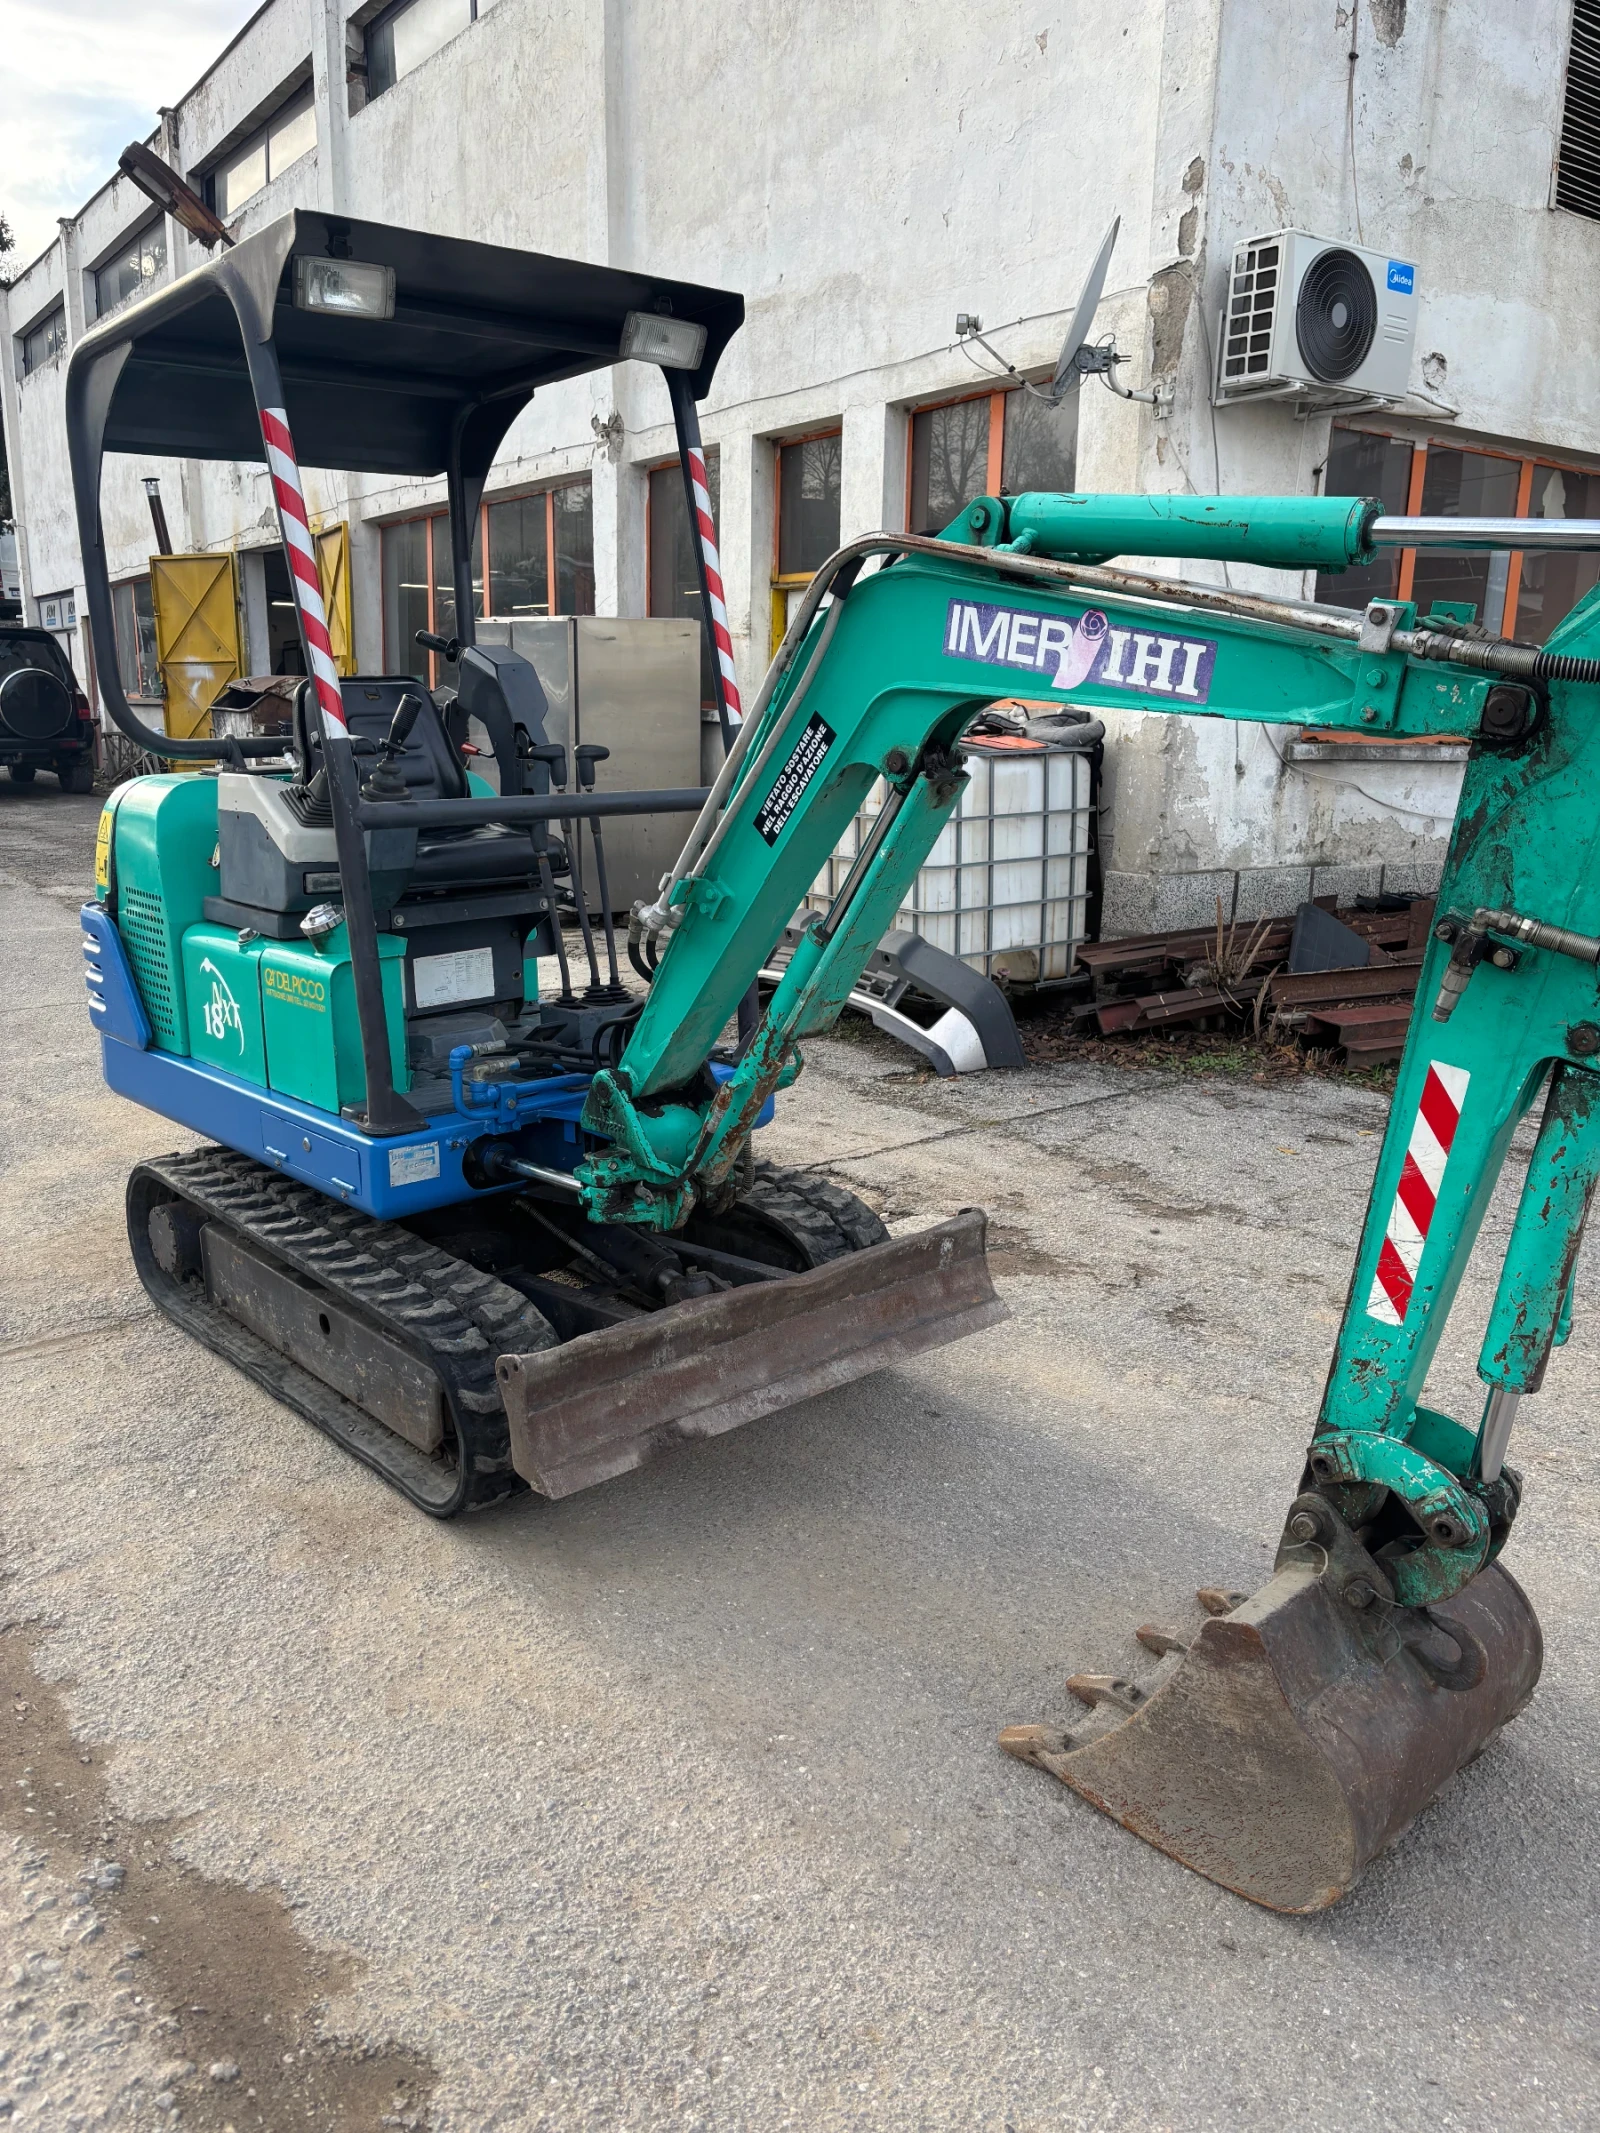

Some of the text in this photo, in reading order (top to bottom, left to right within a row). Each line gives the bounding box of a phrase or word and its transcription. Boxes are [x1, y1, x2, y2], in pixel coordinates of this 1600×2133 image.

[1389, 268, 1412, 286] Midea
[948, 604, 1207, 696] IMER IHI
[761, 726, 814, 817] VIETATO SOSTARE
[762, 723, 828, 836] NEL RAGGIO D'AZIONE
[773, 743, 829, 835] DELL'ESCAVATORE
[276, 971, 293, 992] DEL
[292, 975, 325, 1002] PICCO
